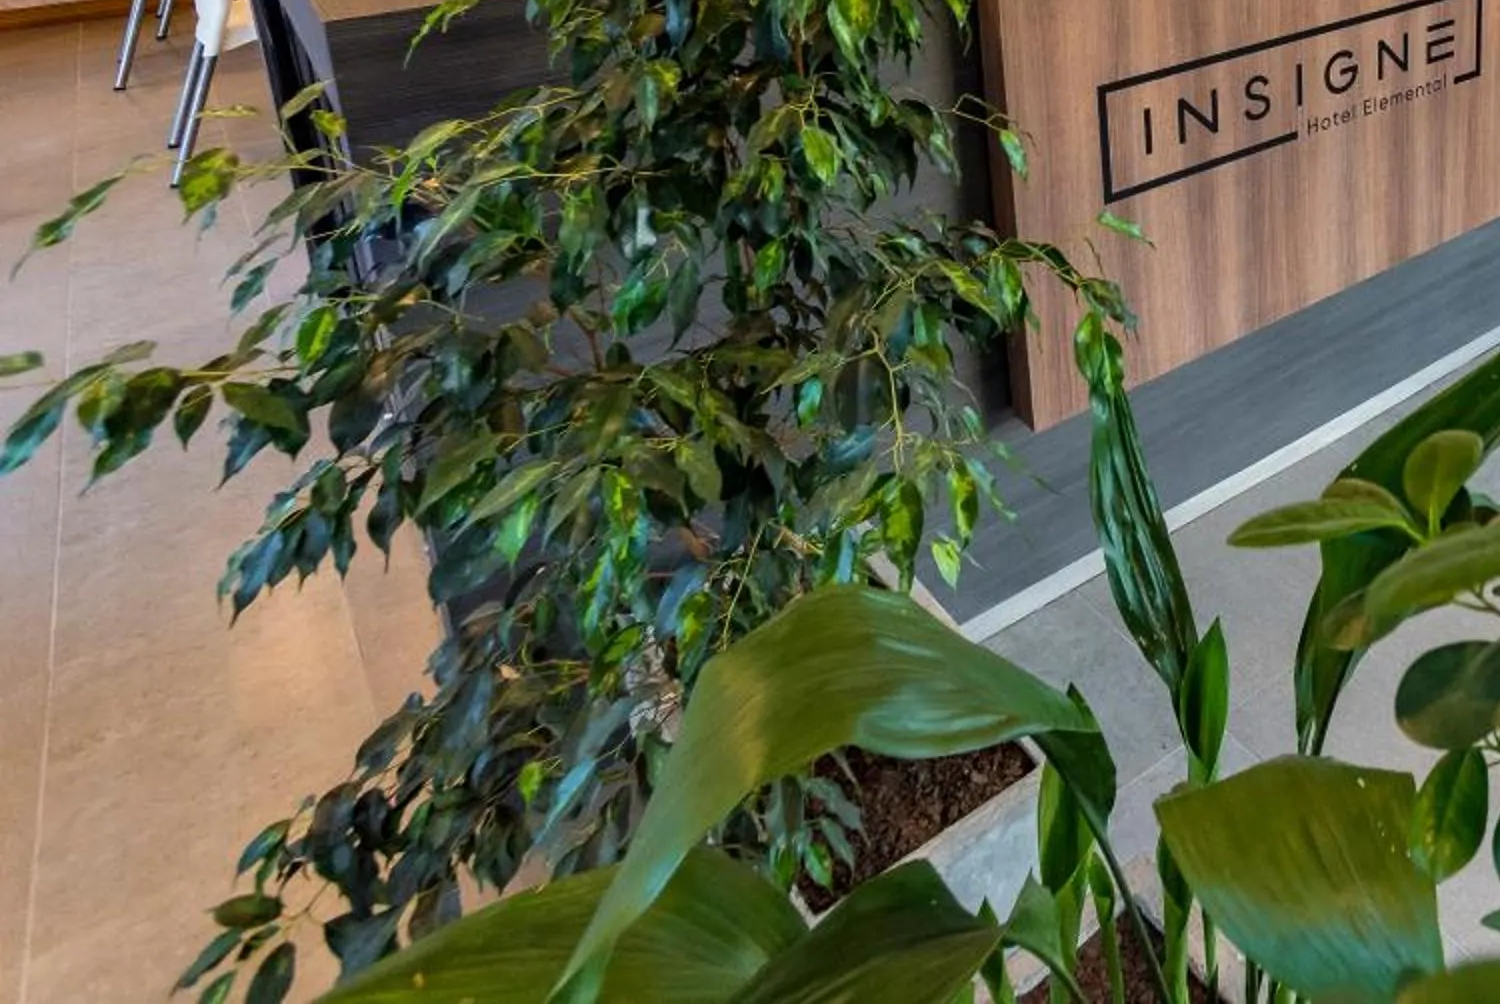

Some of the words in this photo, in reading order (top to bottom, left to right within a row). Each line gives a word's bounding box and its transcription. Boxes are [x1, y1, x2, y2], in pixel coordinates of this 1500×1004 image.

[1143, 19, 1456, 155] INSIGNE
[1307, 104, 1357, 136] Hotel
[1363, 73, 1448, 117] Elemental
